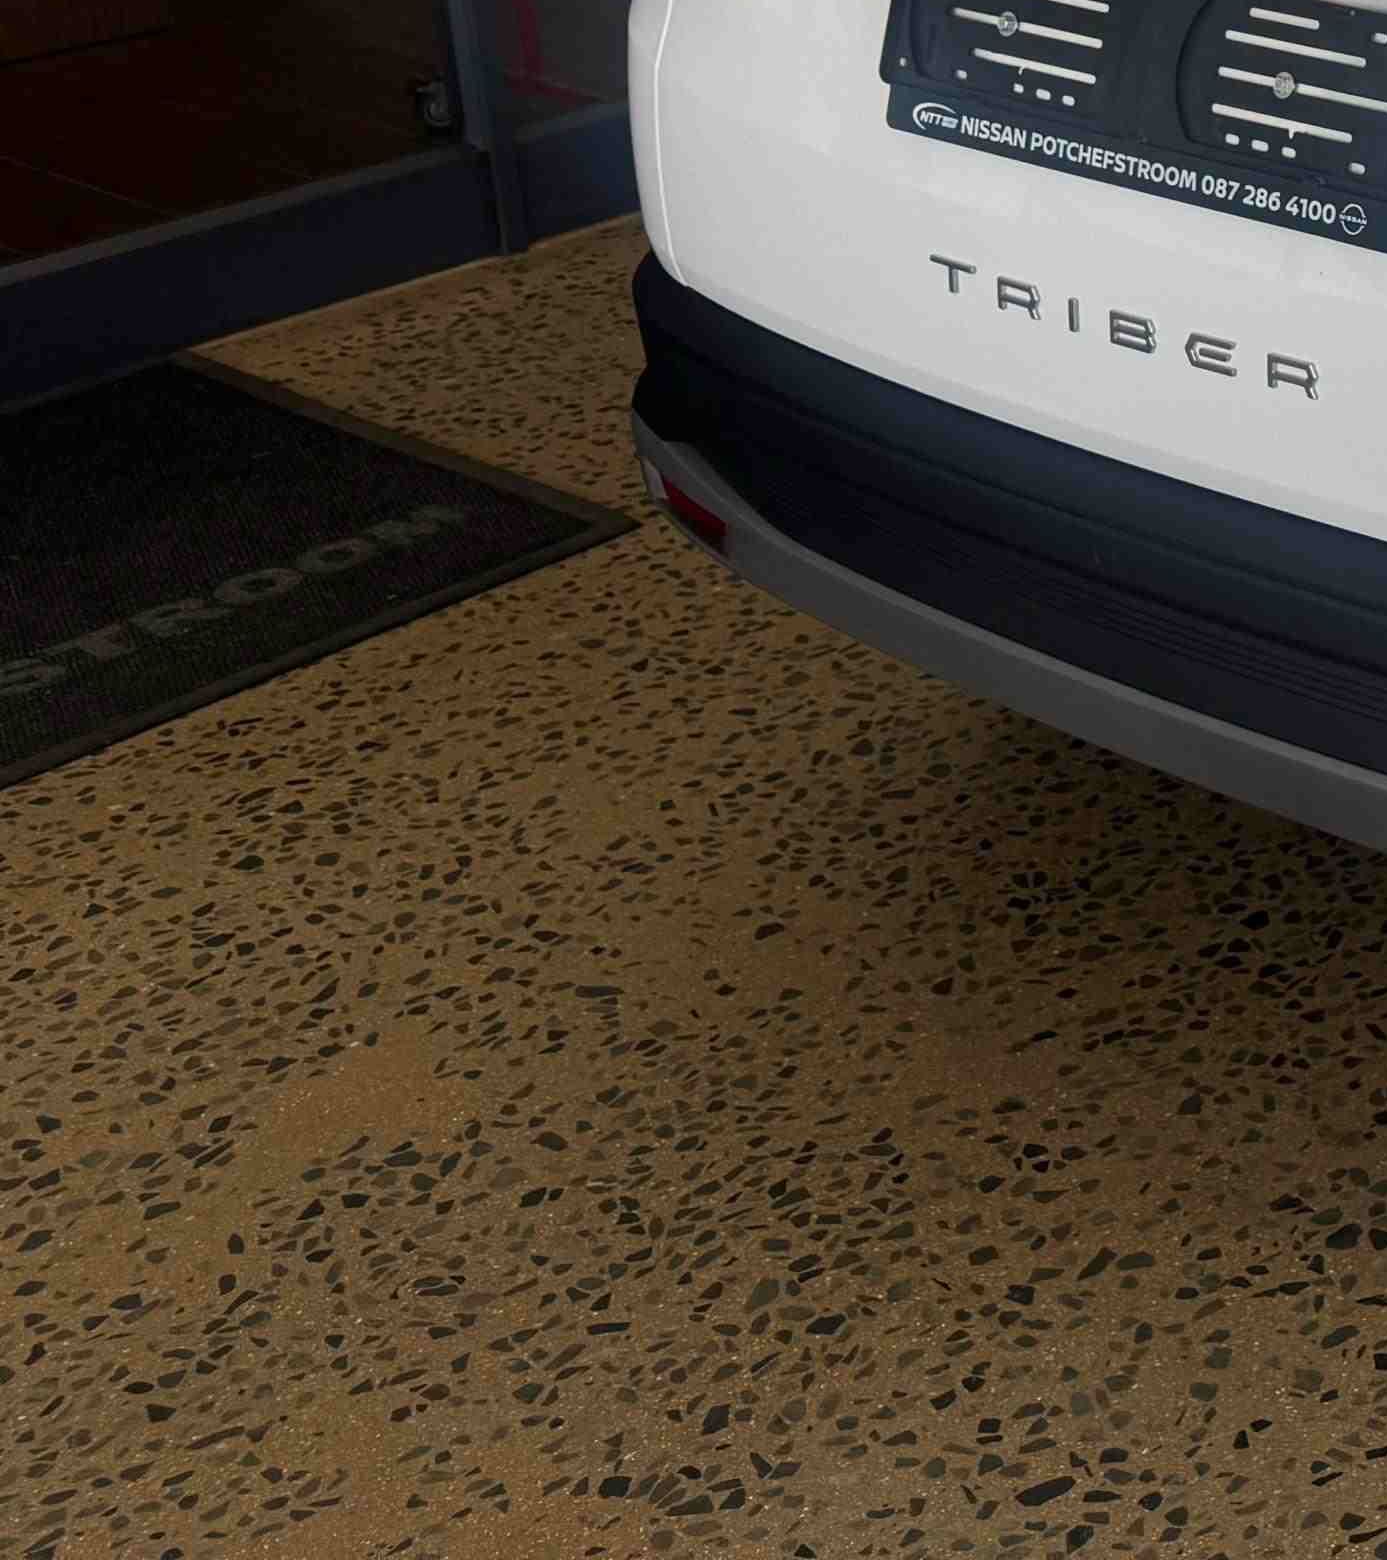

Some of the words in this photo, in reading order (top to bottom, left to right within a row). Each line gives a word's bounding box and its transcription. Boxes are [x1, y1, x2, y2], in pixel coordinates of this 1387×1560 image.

[919, 110, 944, 126] NTT
[960, 115, 1027, 149] NISSAN
[1030, 132, 1197, 192] POTCHEFSTROOM
[1201, 175, 1241, 201] 087
[1242, 184, 1281, 212] 286
[1285, 196, 1337, 225] 4100
[929, 253, 1321, 401] TRIBER
